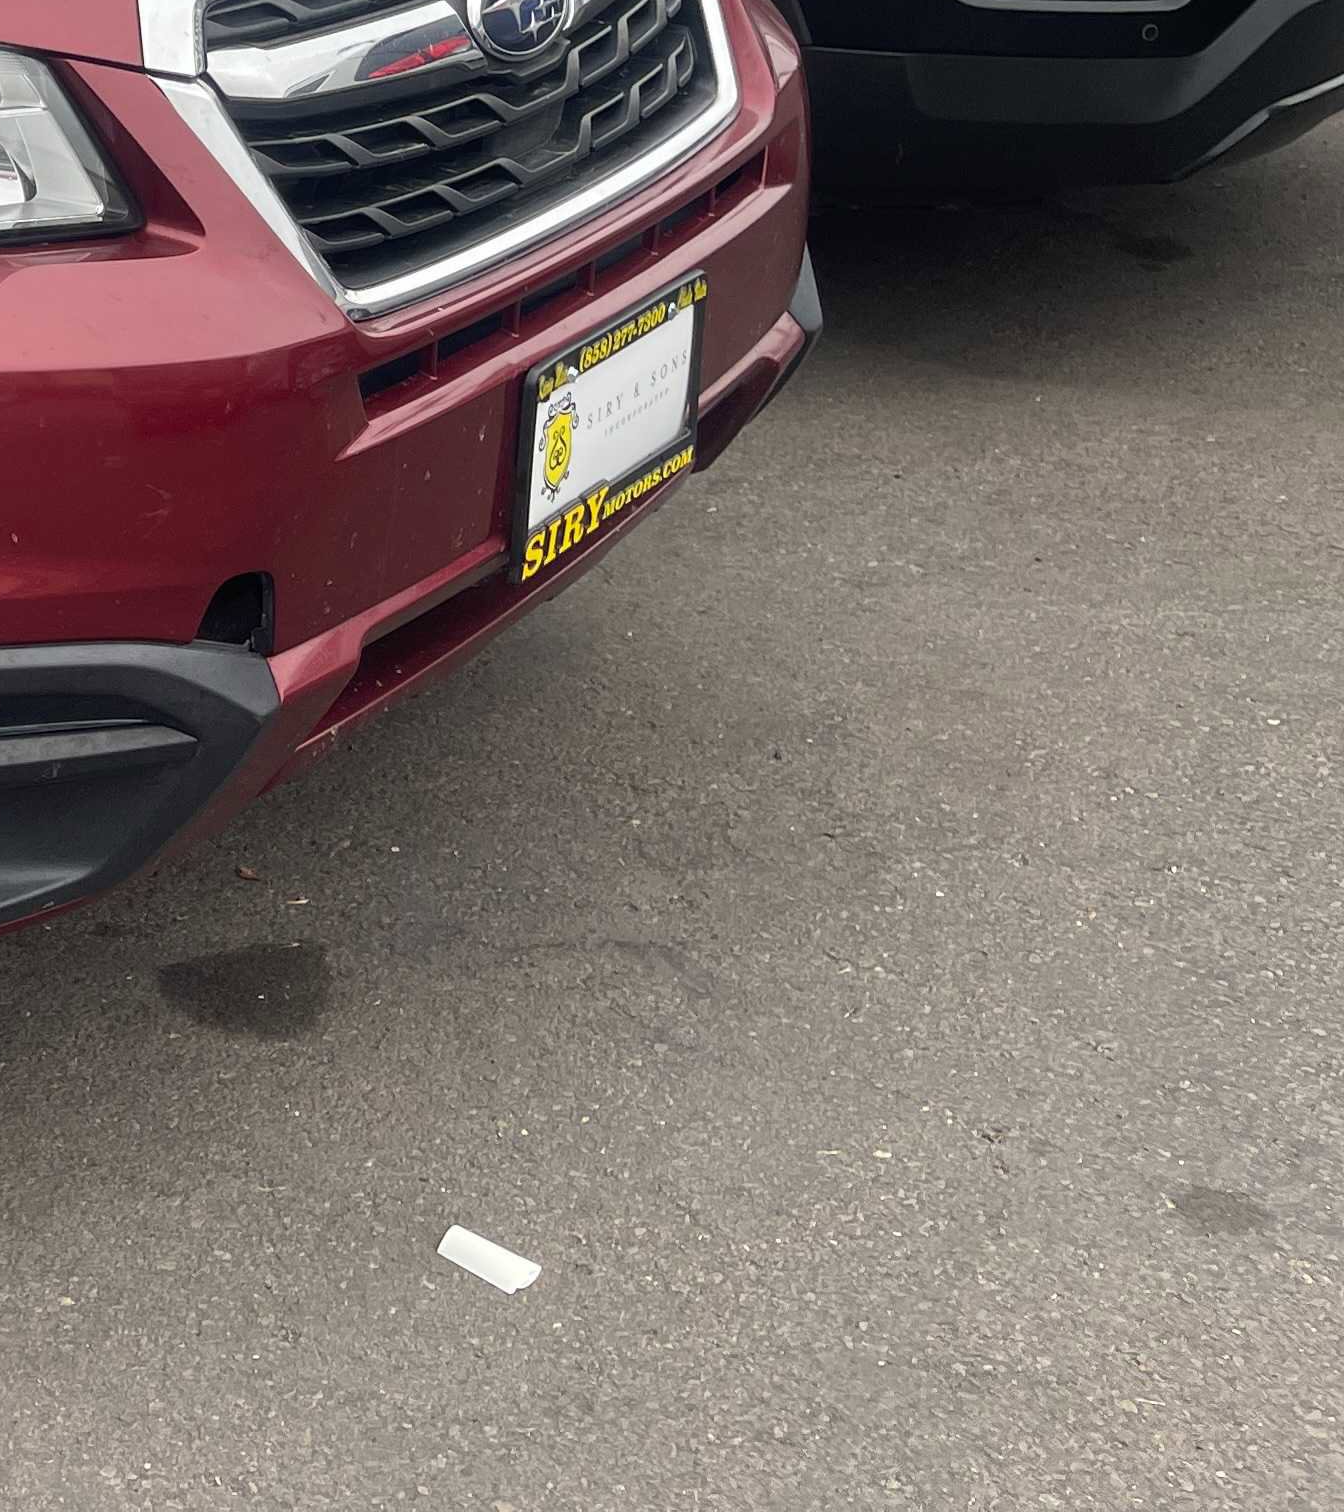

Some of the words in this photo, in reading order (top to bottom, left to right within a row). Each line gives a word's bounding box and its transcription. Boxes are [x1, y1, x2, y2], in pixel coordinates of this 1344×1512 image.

[612, 302, 666, 351] 277-7300
[586, 392, 625, 430] SIRY
[650, 349, 688, 387] SONS
